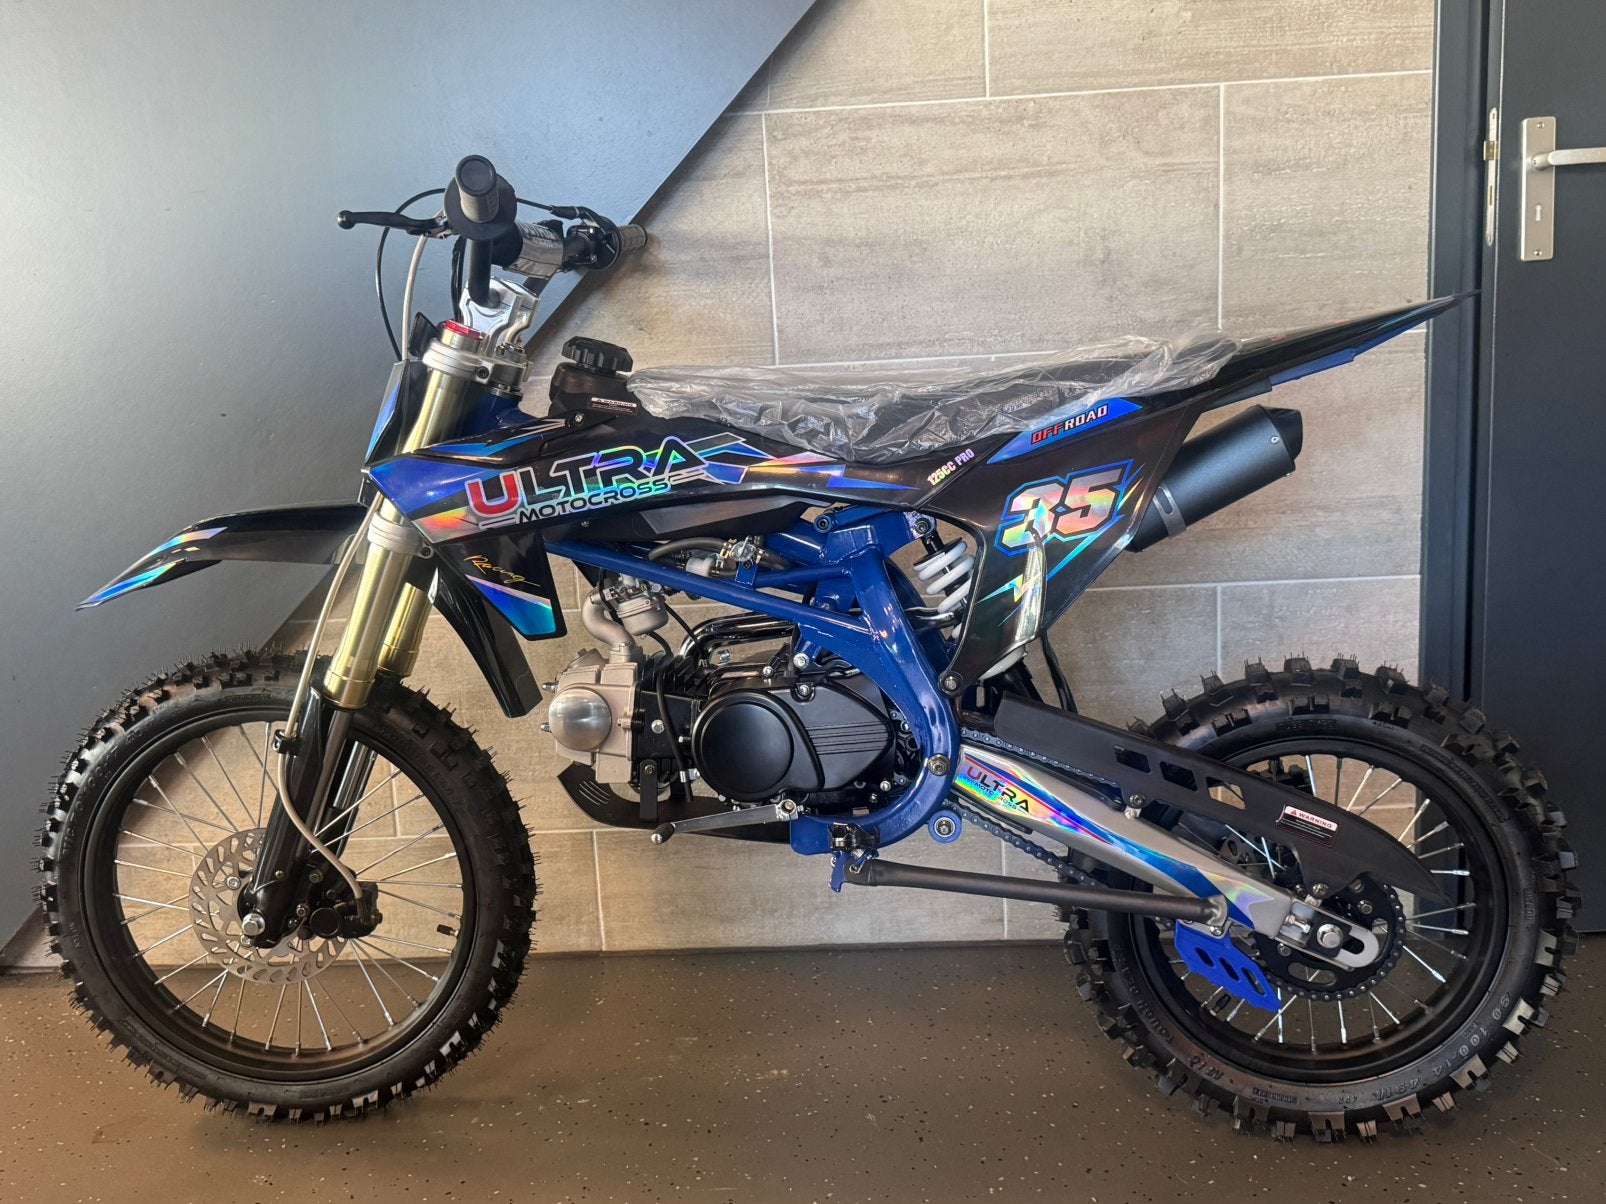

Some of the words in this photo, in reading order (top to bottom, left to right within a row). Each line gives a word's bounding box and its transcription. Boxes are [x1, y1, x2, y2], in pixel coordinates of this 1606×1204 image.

[1031, 404, 1109, 444] OFFROAD
[466, 436, 709, 517] ULTRA
[927, 461, 956, 485] 125CC
[954, 448, 975, 465] PRO
[519, 477, 669, 525] MOTOCROSS
[1001, 466, 1124, 549] 35
[464, 555, 541, 587] Racing
[967, 766, 1029, 813] ULTRA
[1298, 811, 1334, 829] WARNING
